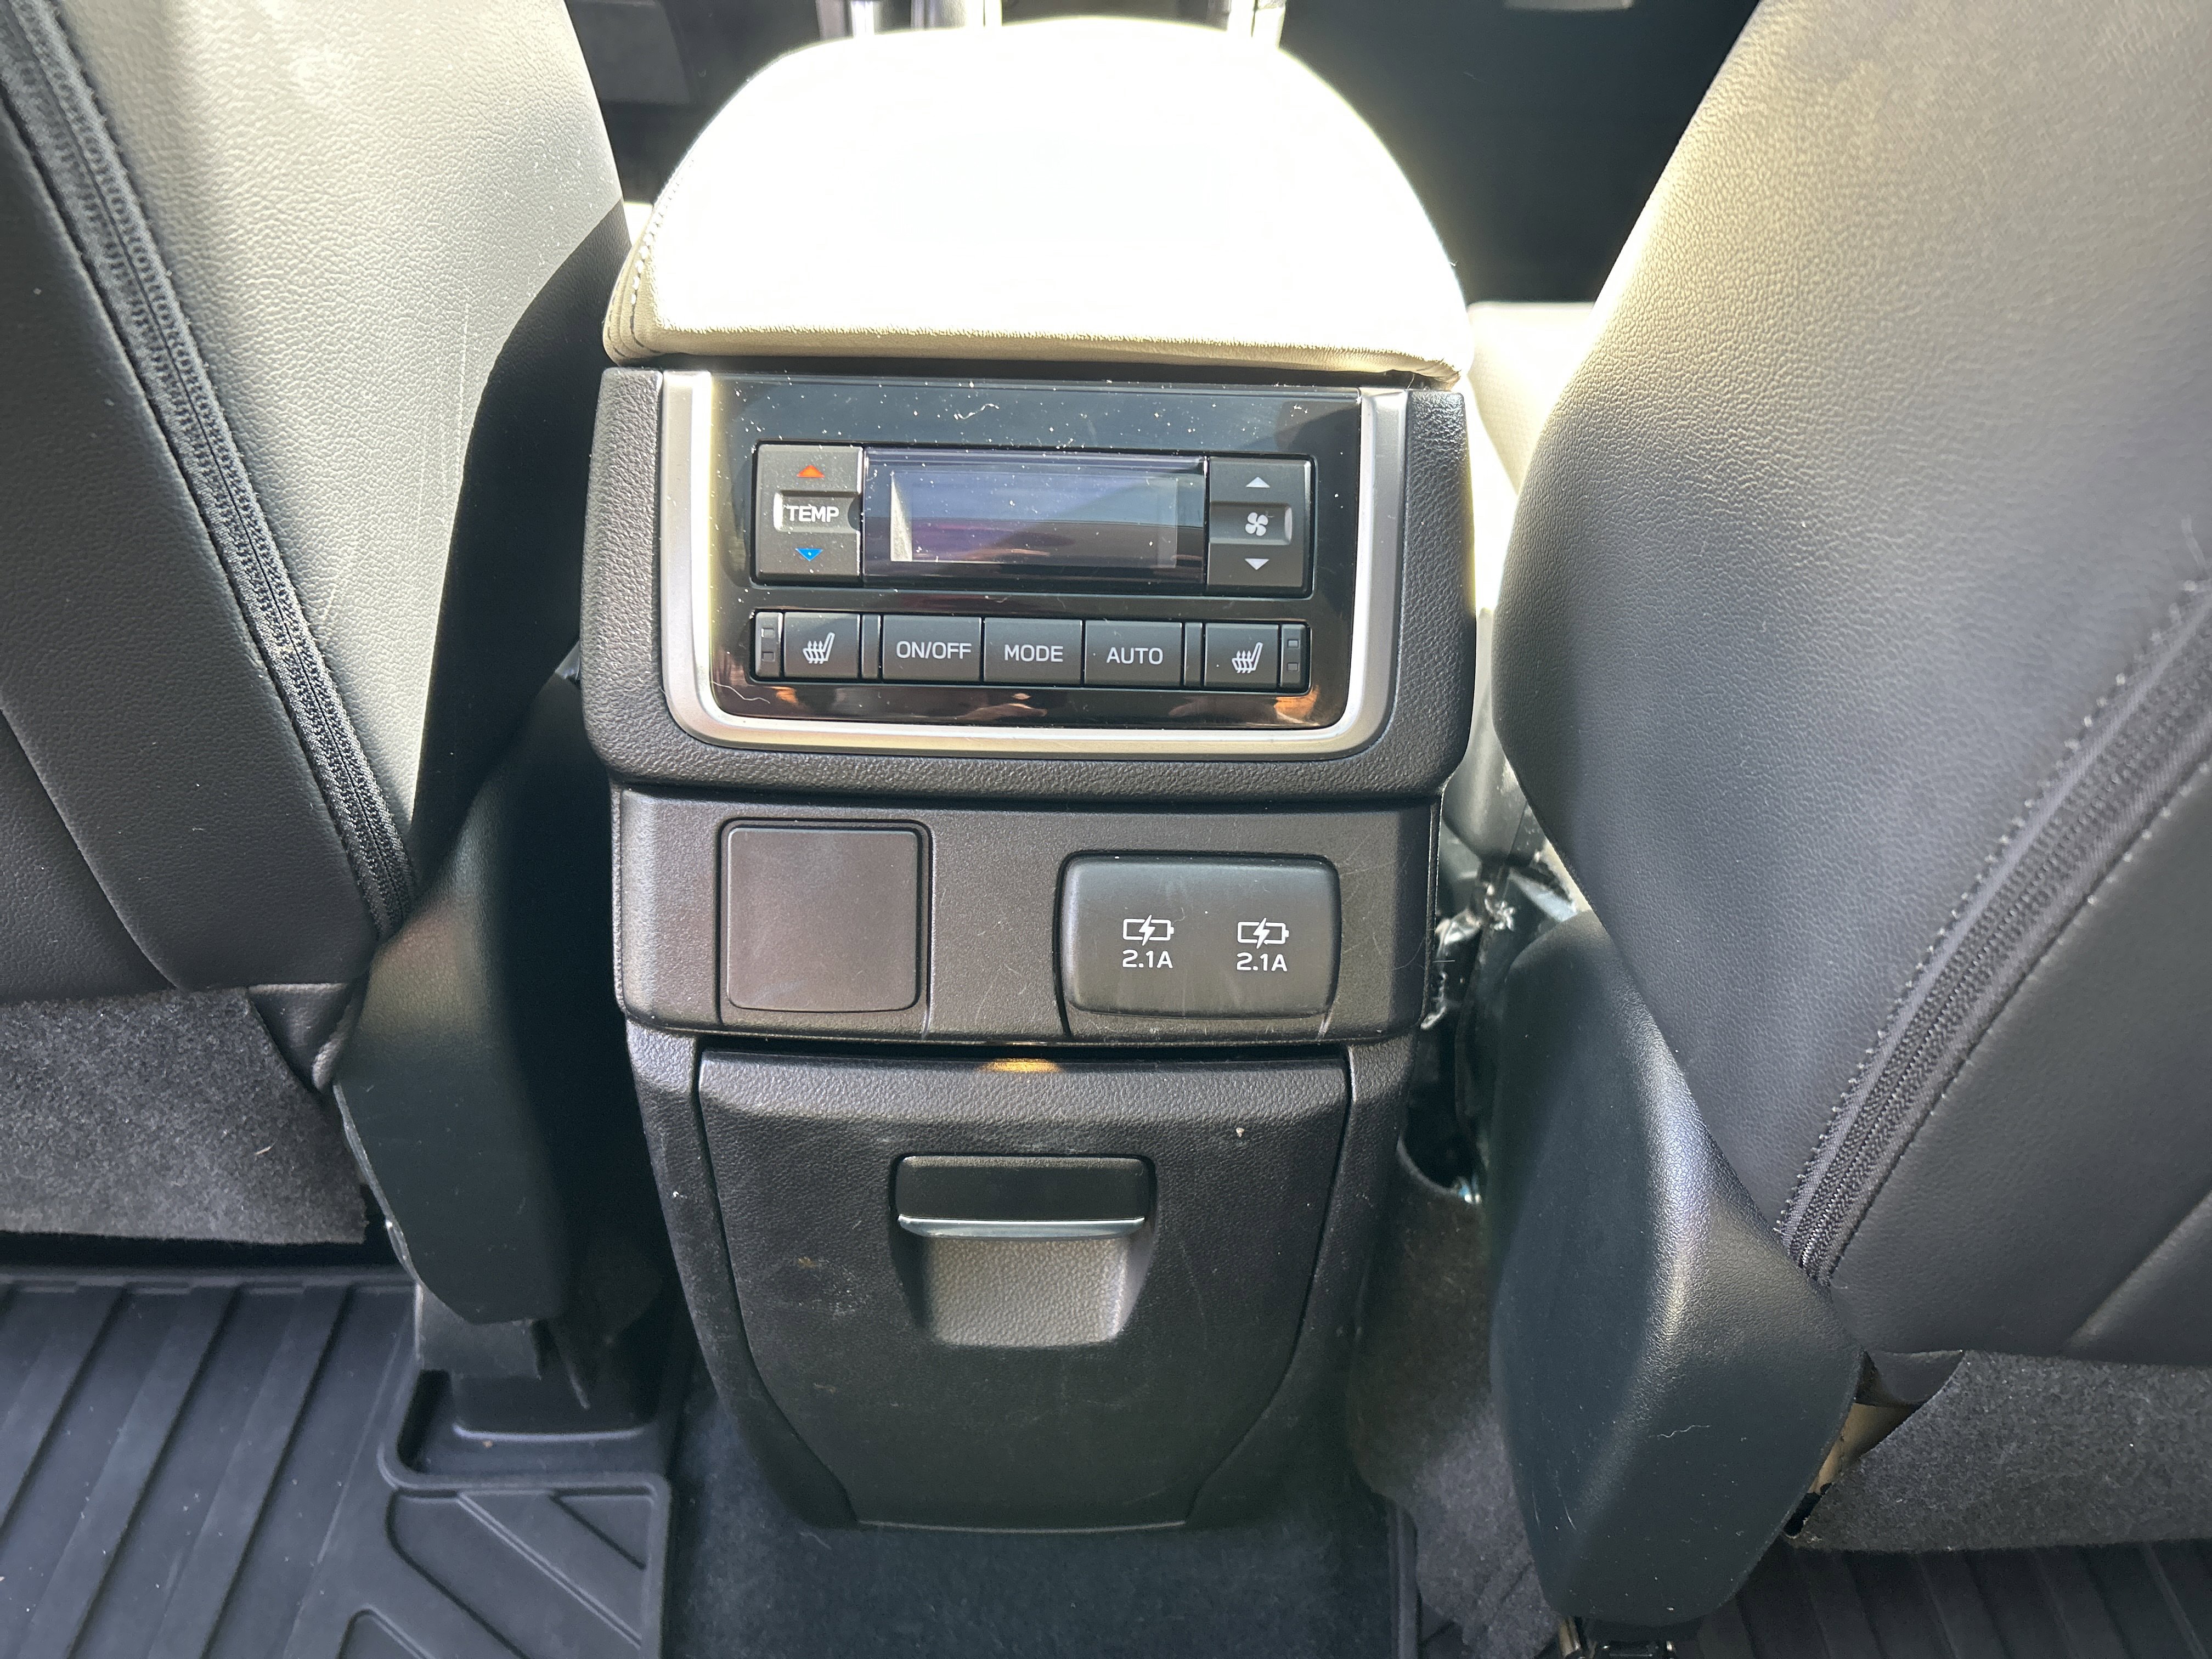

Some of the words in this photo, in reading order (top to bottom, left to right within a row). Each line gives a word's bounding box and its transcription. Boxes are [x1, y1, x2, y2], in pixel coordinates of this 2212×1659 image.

[786, 505, 839, 523] TEMP
[896, 640, 972, 660] ON/OFF
[1005, 645, 1064, 663] MODE
[1106, 647, 1164, 665] AUTO
[1122, 949, 1173, 969] 2.1A
[1236, 952, 1288, 972] 2.1A
